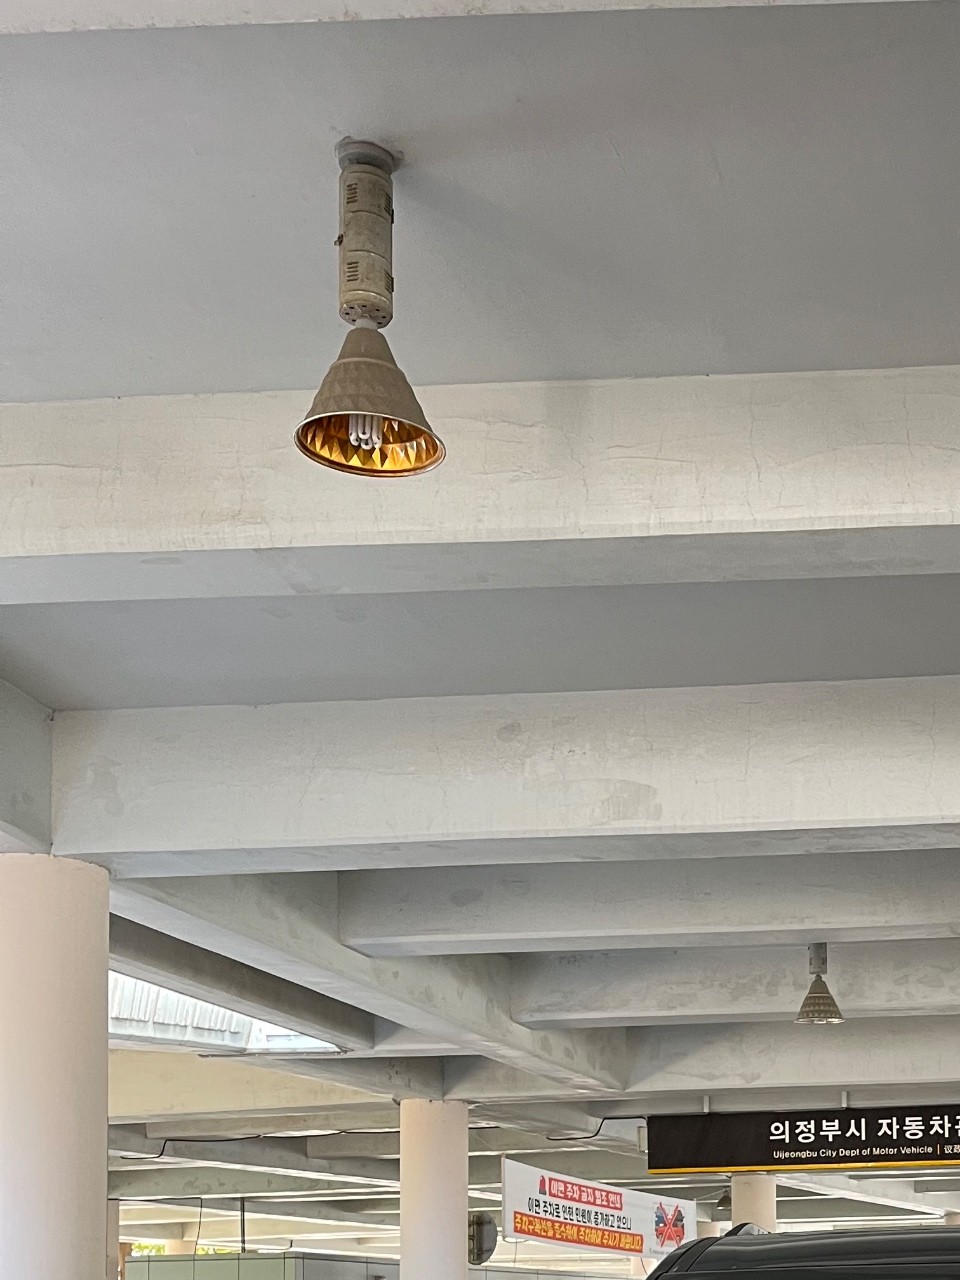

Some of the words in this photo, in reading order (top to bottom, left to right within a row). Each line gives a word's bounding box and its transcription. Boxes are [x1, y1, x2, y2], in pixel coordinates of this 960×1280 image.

[769, 1118, 867, 1144] 의정부시
[773, 1149, 818, 1160] Uijeongbu
[819, 1147, 838, 1159] City
[839, 1147, 860, 1159] Dept
[861, 1147, 871, 1157] of
[872, 1145, 898, 1156] Motor
[899, 1144, 934, 1155] Vehicle
[566, 1183, 580, 1200] 주차
